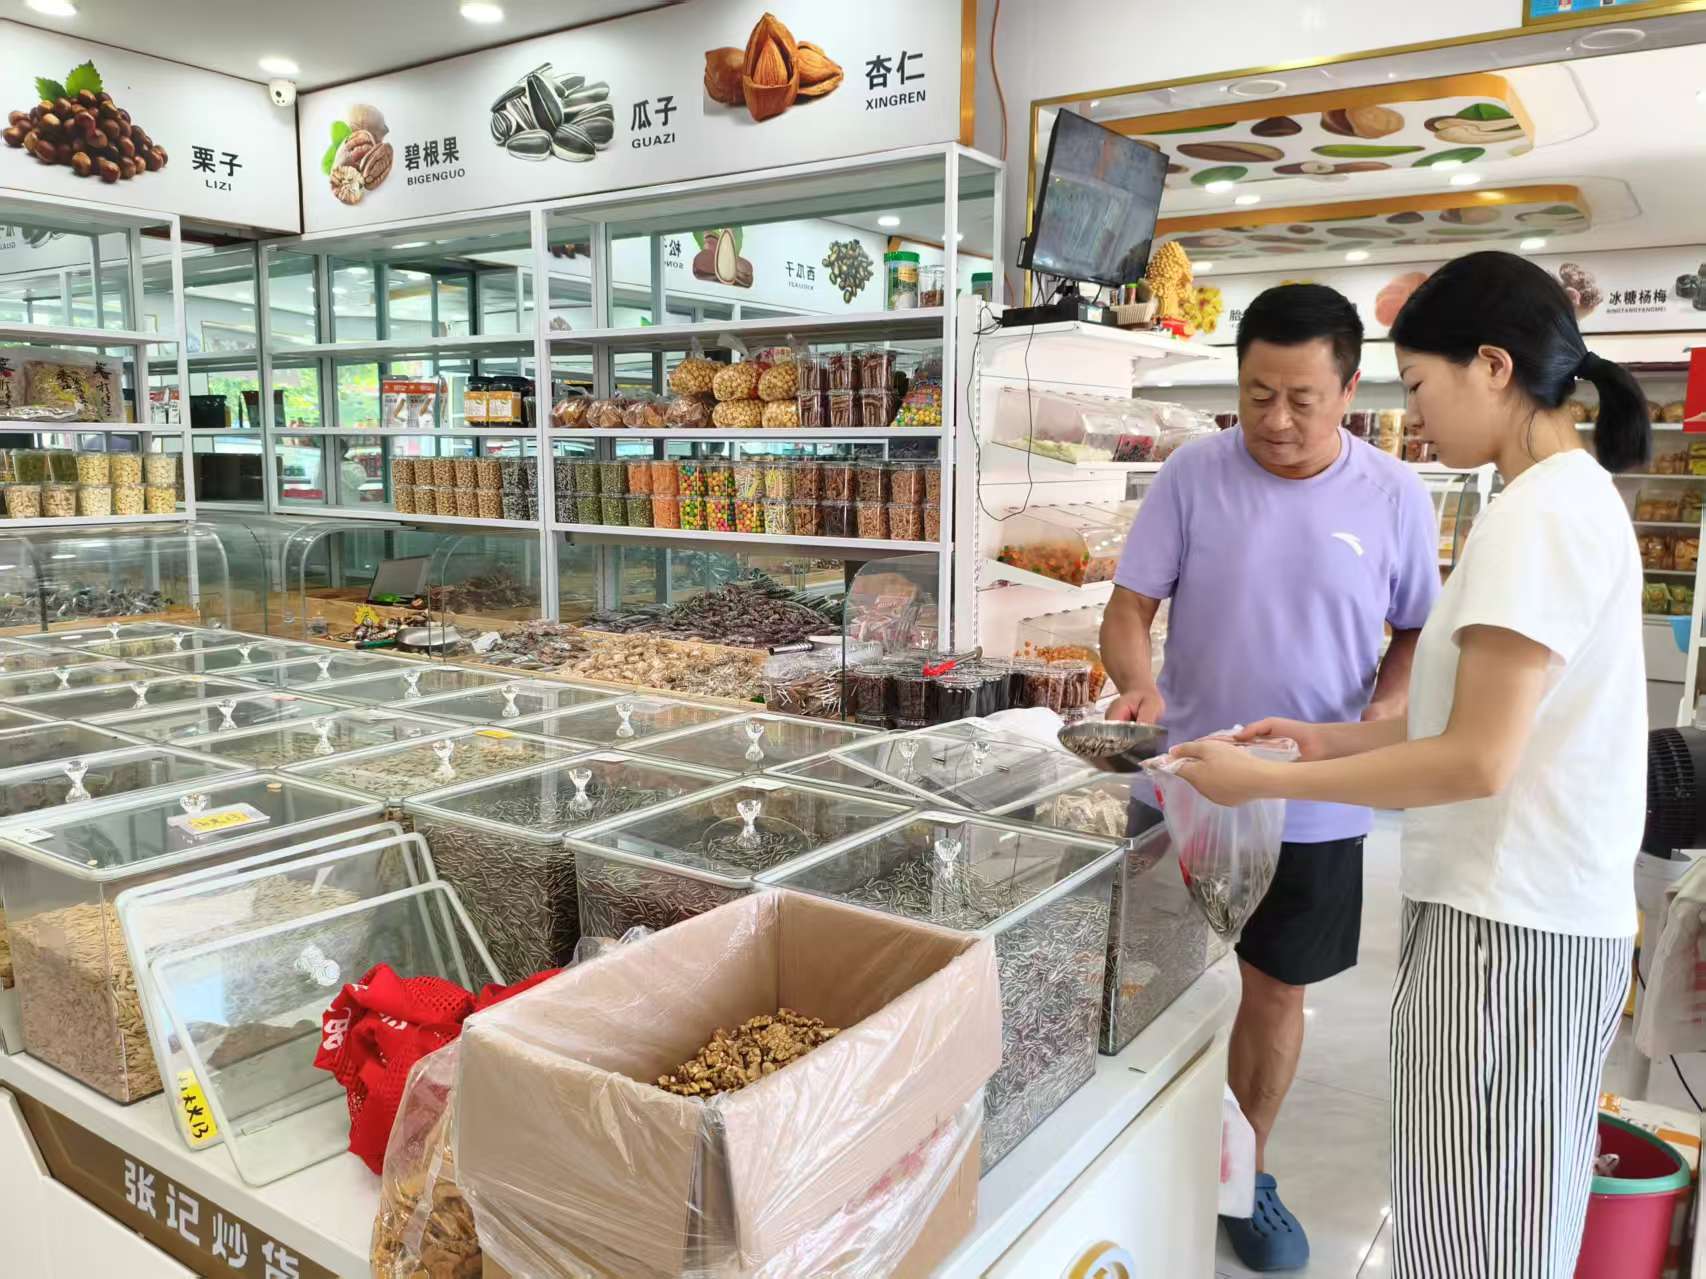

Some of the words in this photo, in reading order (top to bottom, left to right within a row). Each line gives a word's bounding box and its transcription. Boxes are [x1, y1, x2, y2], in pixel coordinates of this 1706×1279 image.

[866, 51, 925, 90] 杏仁
[866, 90, 926, 110] XINGREN
[631, 96, 677, 131] 瓜子
[632, 133, 675, 148] GUAZI
[192, 145, 243, 176] 栗子
[405, 137, 459, 170] 碧根果
[206, 180, 231, 191] LIZI
[407, 168, 465, 186] BIGENGUO
[1608, 289, 1667, 305] 冰糖杨梅
[124, 1159, 300, 1279] 张记炒货
